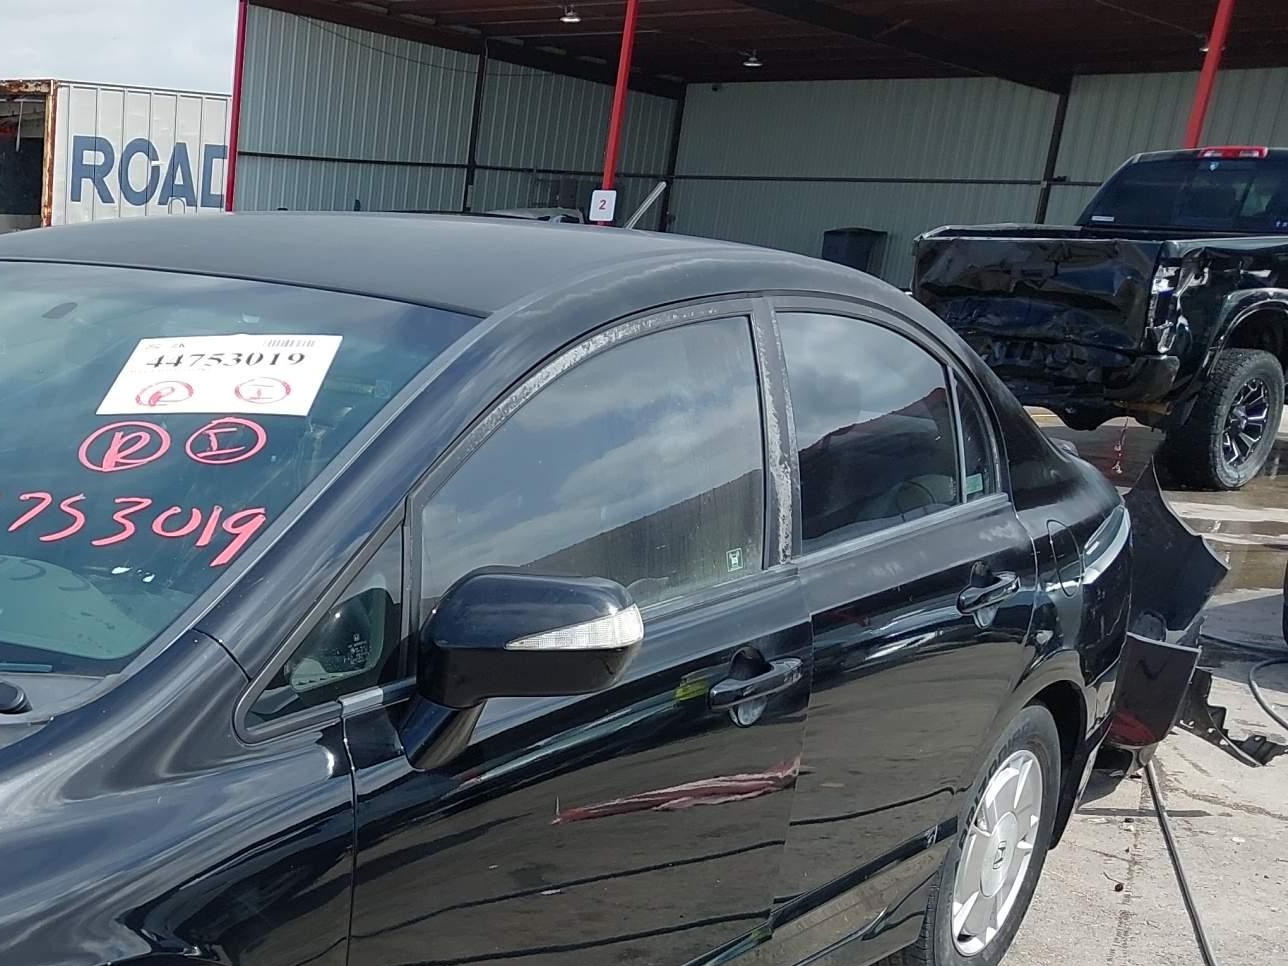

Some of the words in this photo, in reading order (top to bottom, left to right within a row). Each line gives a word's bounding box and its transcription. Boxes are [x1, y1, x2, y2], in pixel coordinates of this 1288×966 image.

[71, 136, 228, 207] ROAD
[599, 200, 606, 210] 2
[146, 352, 306, 369] 44753019
